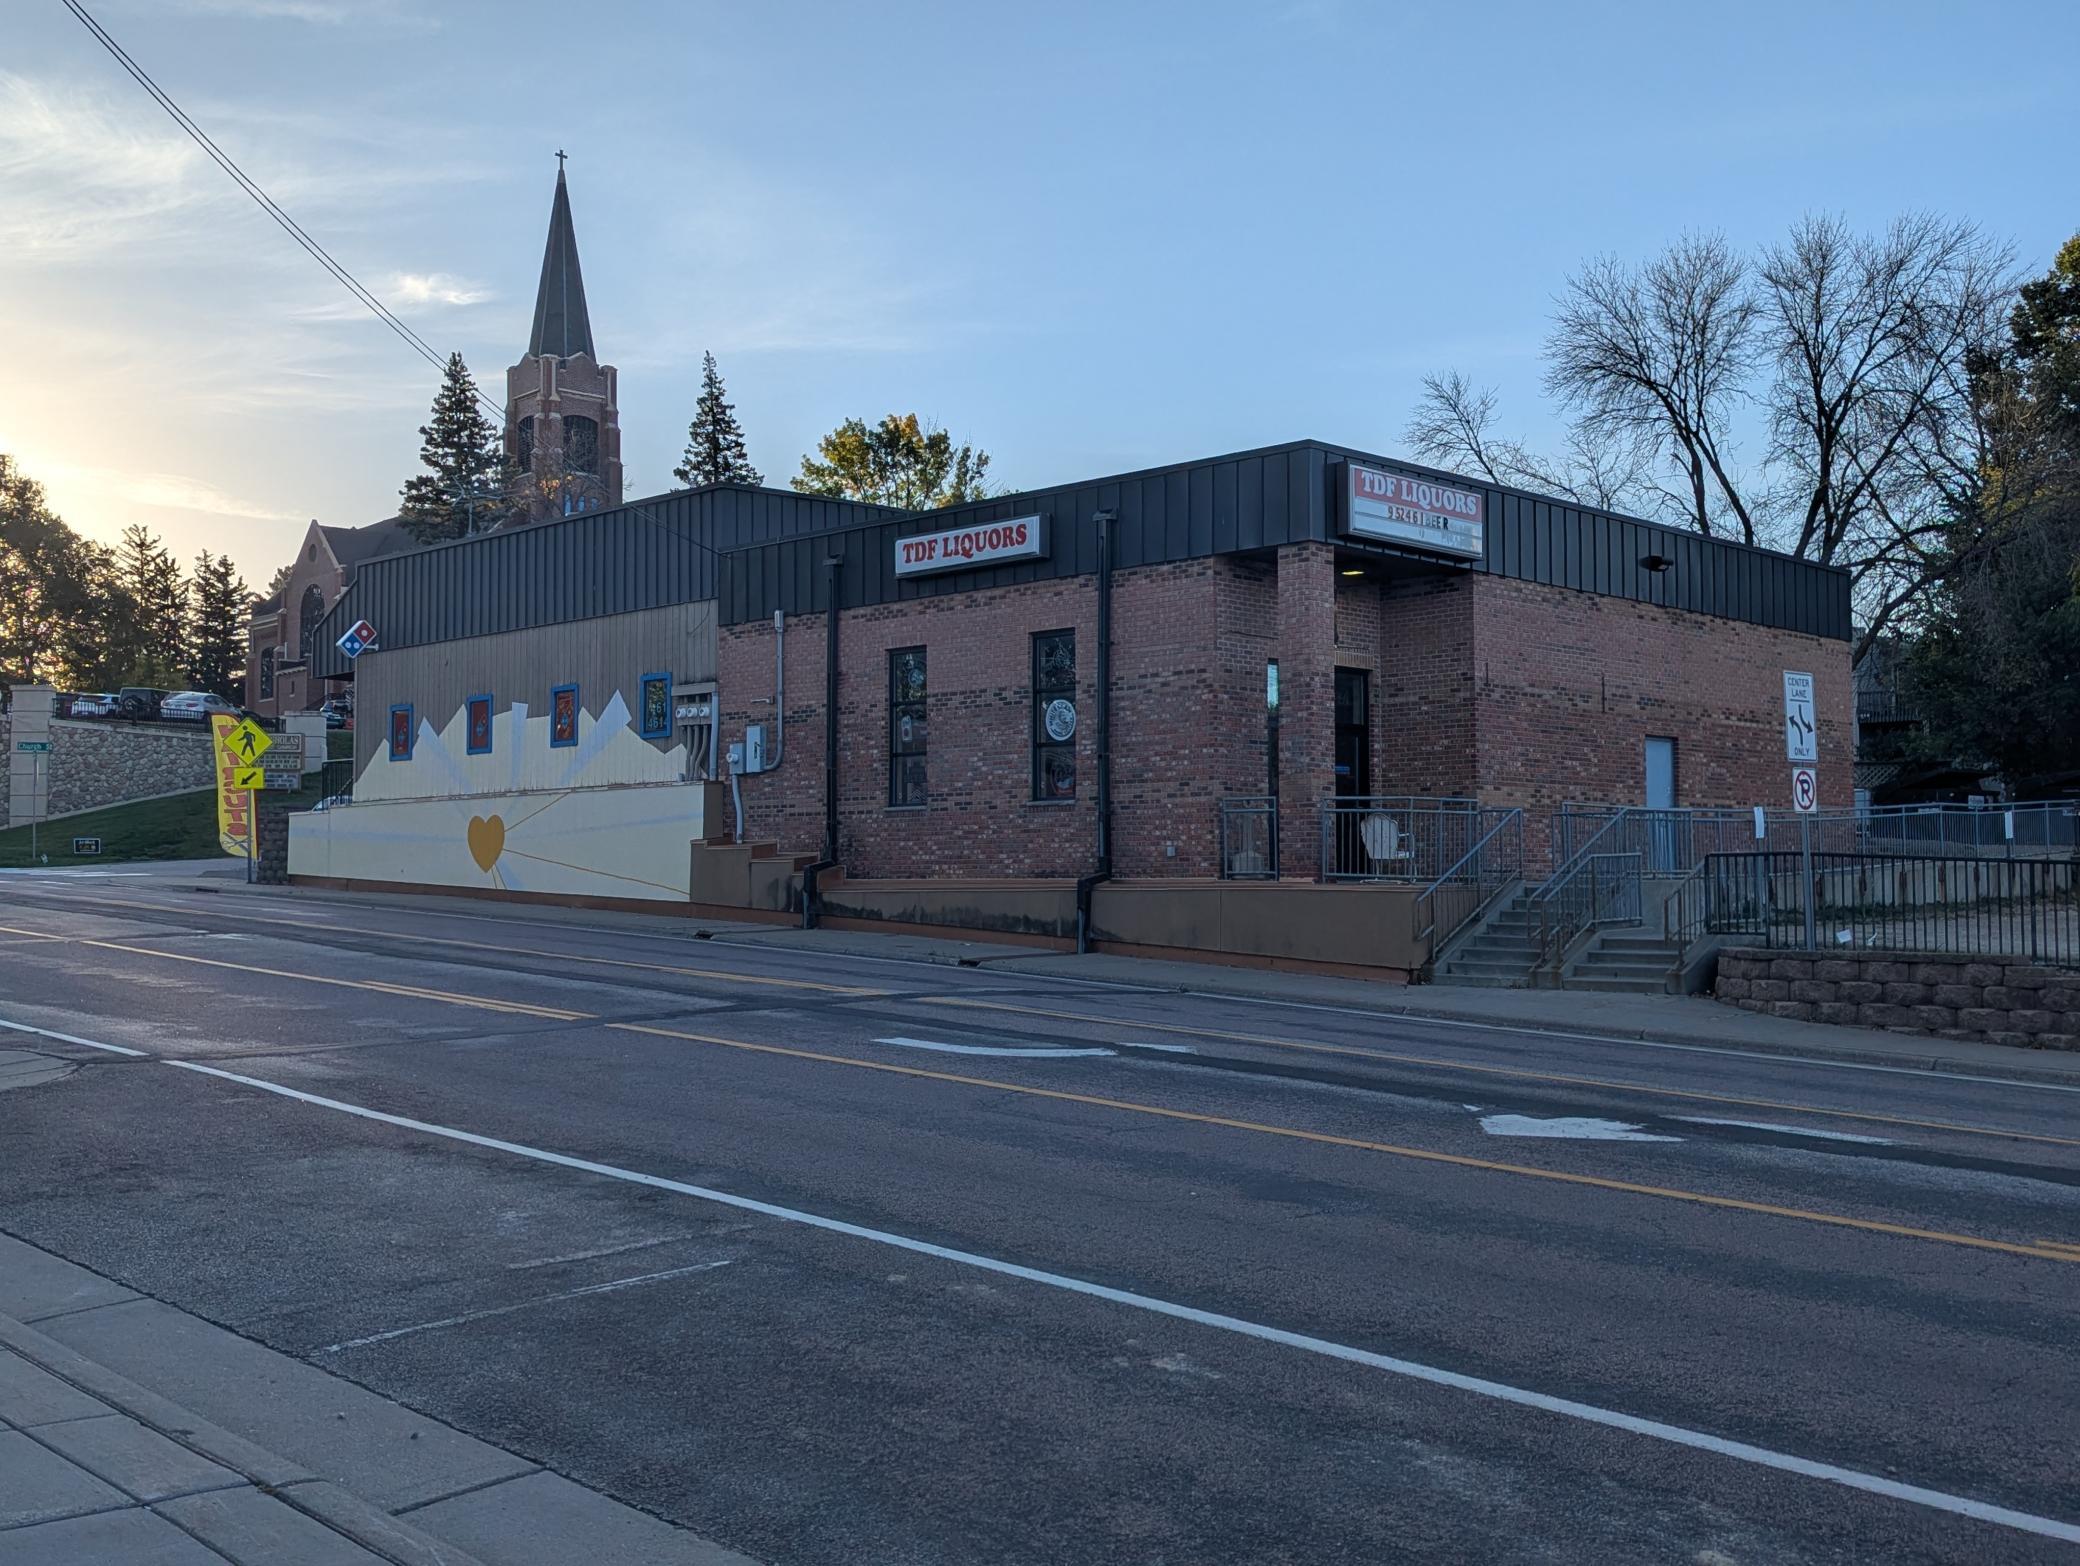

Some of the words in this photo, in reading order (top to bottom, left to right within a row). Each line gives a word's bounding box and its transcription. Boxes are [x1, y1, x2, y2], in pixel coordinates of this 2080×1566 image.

[1361, 471, 1397, 498] TDF
[1400, 480, 1478, 516] LIQUORS
[902, 538, 939, 564] TDF
[942, 523, 1028, 560] LIQUORS
[1787, 676, 1810, 687] CENTER
[1791, 687, 1807, 699] LANE
[18, 743, 42, 751] Church
[1794, 746, 1810, 757] ONLY
